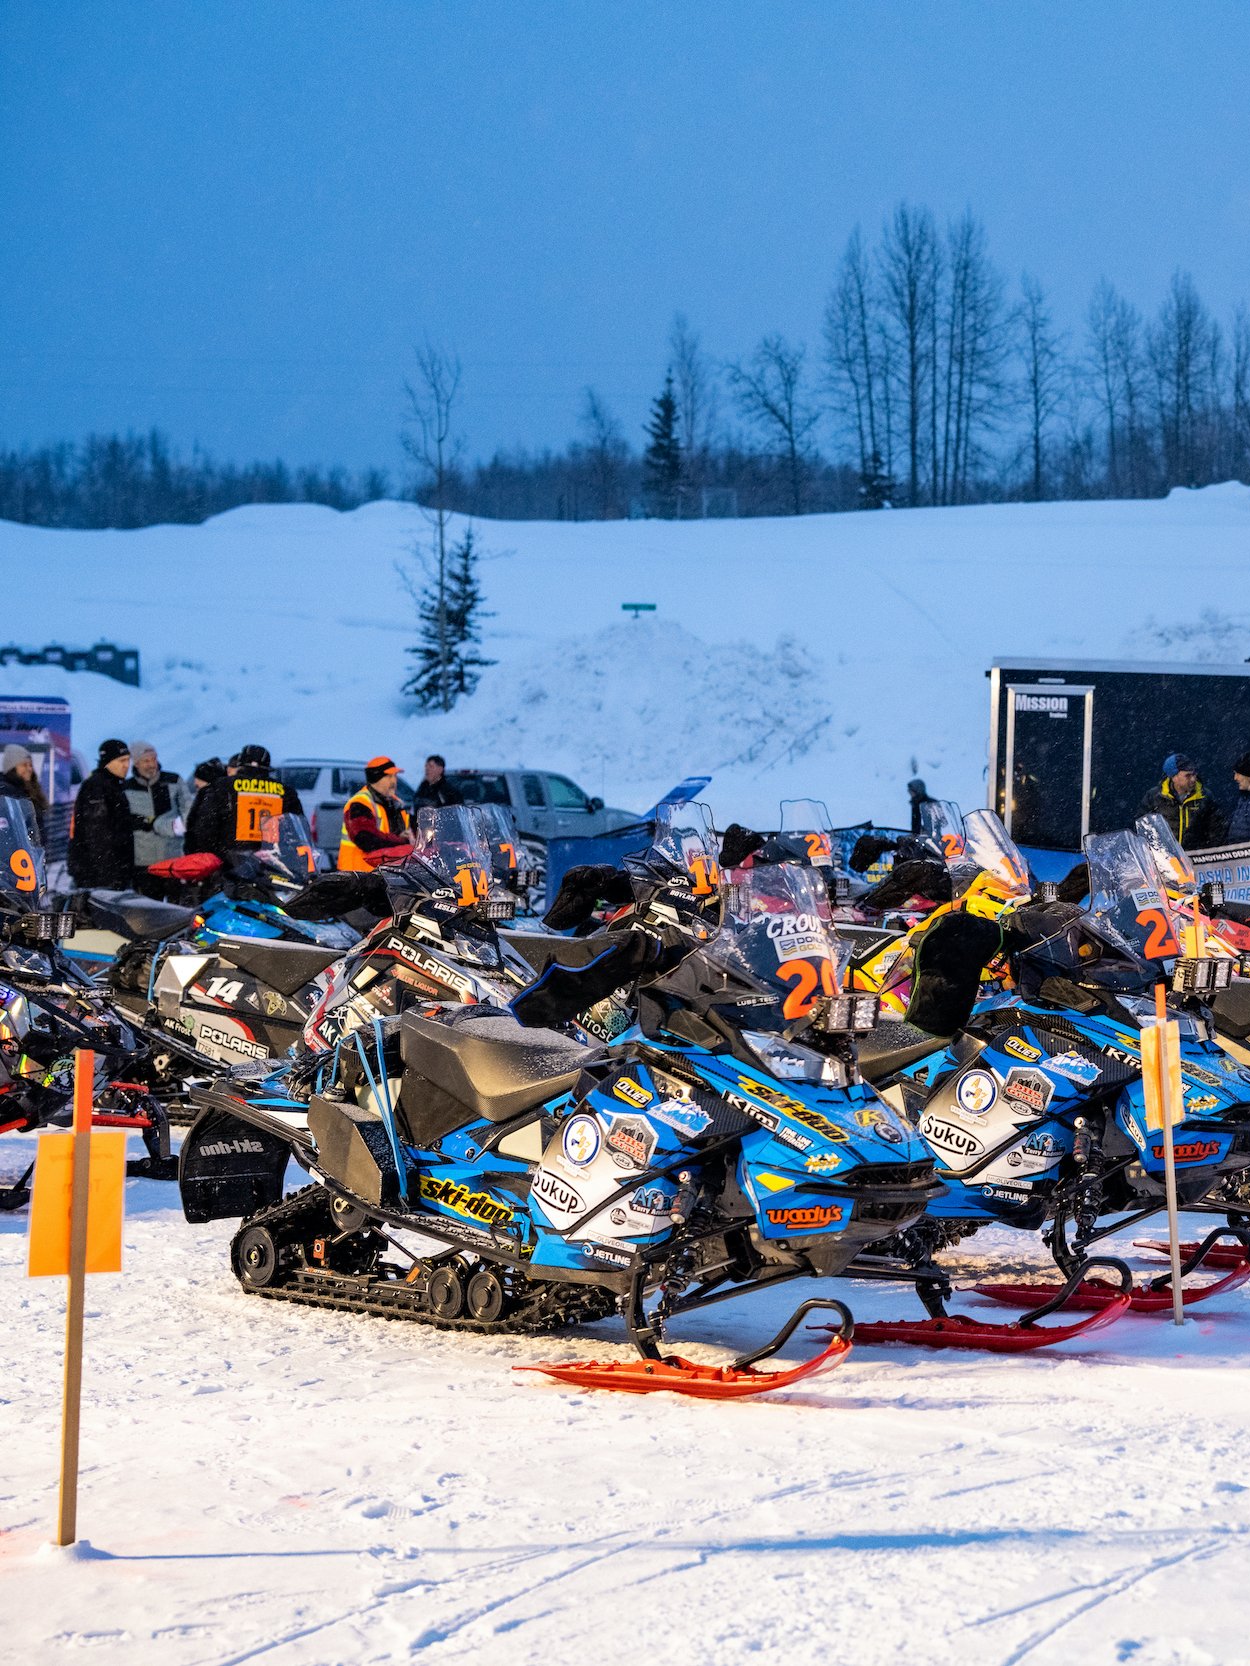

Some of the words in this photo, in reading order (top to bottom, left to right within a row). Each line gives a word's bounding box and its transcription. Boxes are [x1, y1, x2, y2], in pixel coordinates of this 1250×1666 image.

[234, 779, 285, 796] COLLINS
[1193, 852, 1233, 863] HANDYMAN
[10, 849, 37, 892] 9
[453, 869, 489, 907] 14
[669, 889, 697, 902] BOYLAN
[434, 902, 461, 914] LESLIE
[387, 936, 472, 991] POLARIS
[206, 977, 244, 1003] 14
[414, 980, 439, 996] LIQUOR
[164, 1019, 176, 1031] AK
[175, 1022, 192, 1037] Frost
[319, 1020, 336, 1042] AK
[582, 1012, 614, 1043] Frost
[200, 1025, 269, 1060] POLARIS
[1007, 1039, 1038, 1060] OLLIES
[616, 1081, 651, 1104] OLLIES
[924, 1115, 977, 1157] Sukup
[423, 1179, 512, 1222] ski-doo
[632, 1204, 650, 1214] Terry
[767, 1206, 842, 1229] woody's
[594, 1249, 632, 1267] JETLINE
